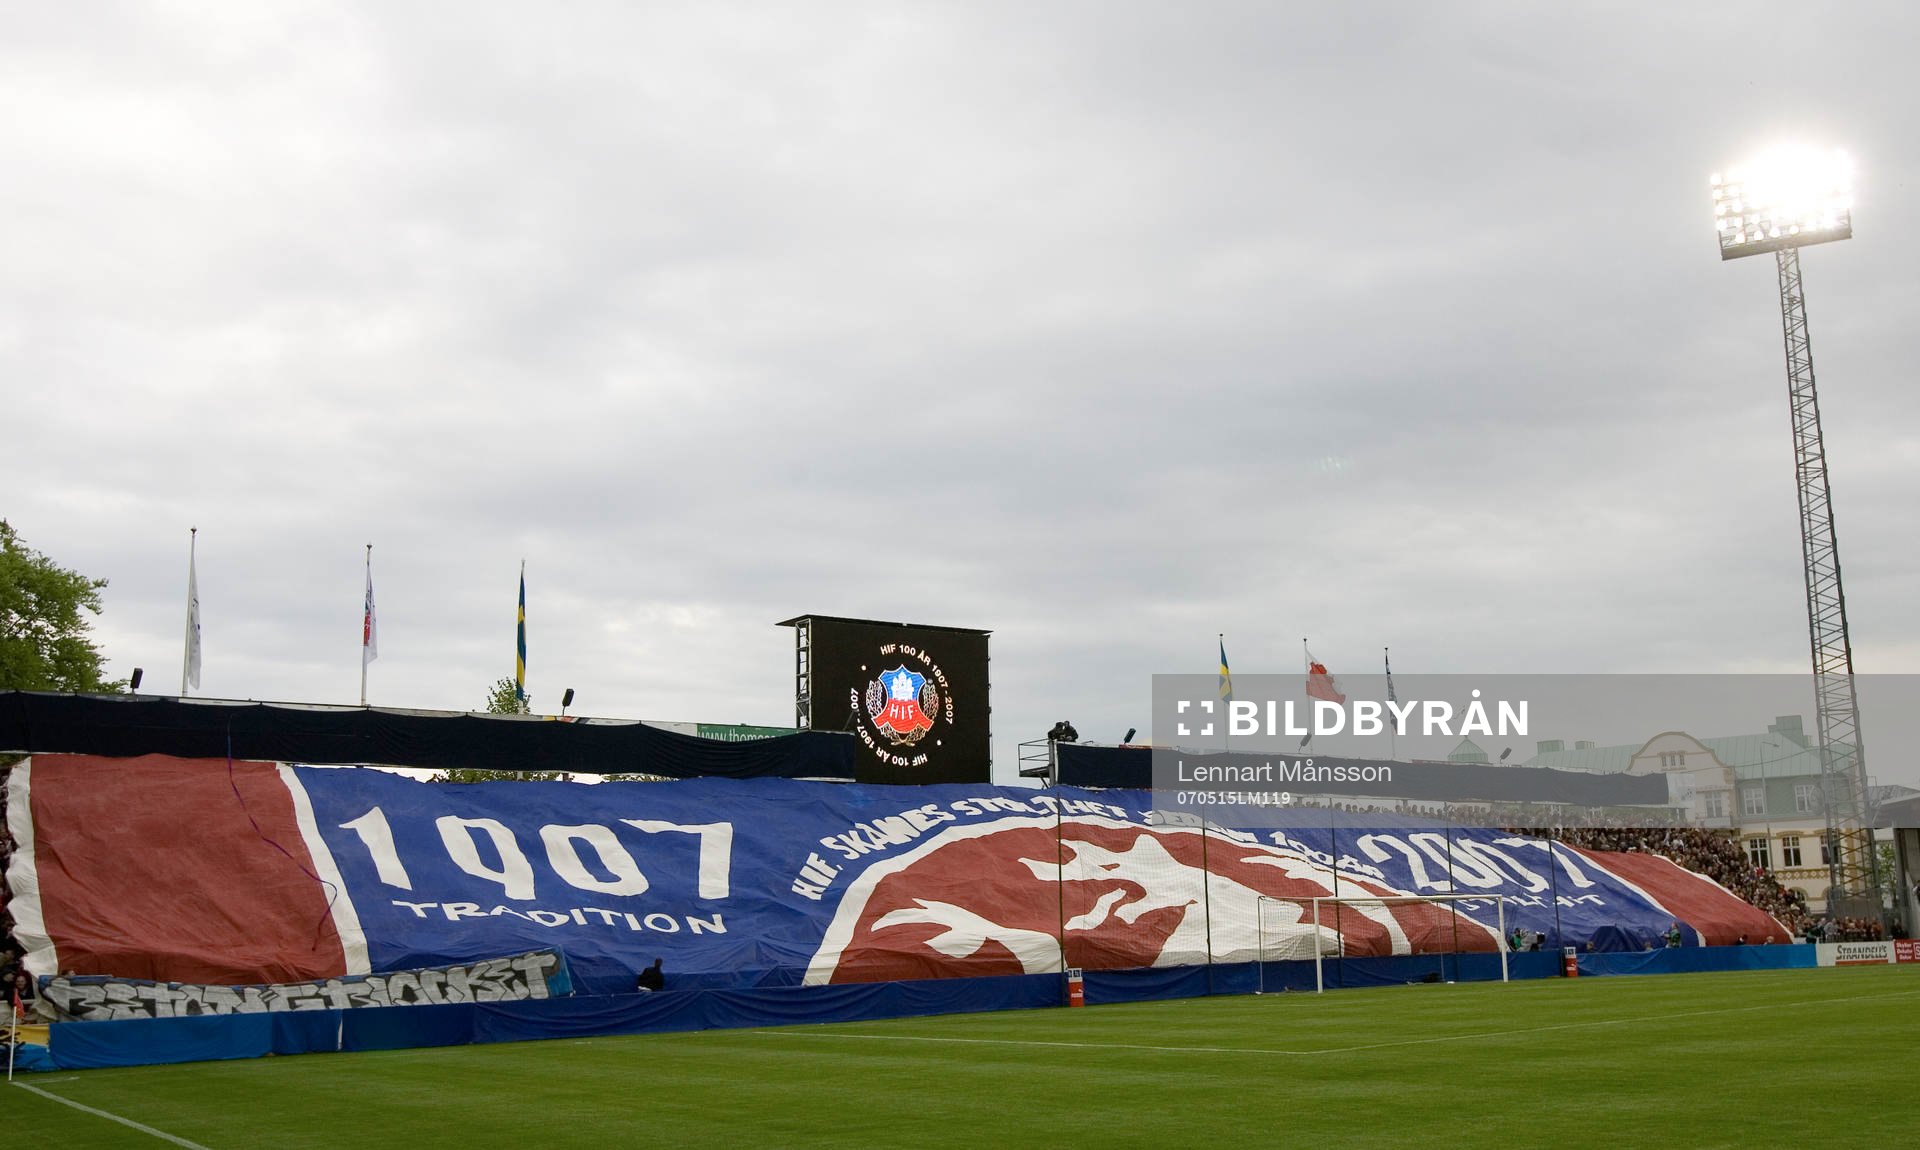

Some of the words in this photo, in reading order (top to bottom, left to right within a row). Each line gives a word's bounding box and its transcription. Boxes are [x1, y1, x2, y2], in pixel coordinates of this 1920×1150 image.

[880, 643, 897, 656] HIF
[899, 644, 916, 656] 100
[917, 650, 931, 666] ÅR
[931, 665, 949, 688] 1907
[945, 696, 954, 724] 2007
[850, 687, 861, 713] 007
[856, 725, 875, 749] 1907
[875, 746, 891, 763] ÅR
[892, 756, 910, 767] 100
[912, 753, 928, 767] HIF
[950, 795, 1129, 819] STOLTHET
[338, 806, 733, 900] 1907
[1356, 832, 1596, 893] 2007
[391, 900, 728, 934] TRADITION
